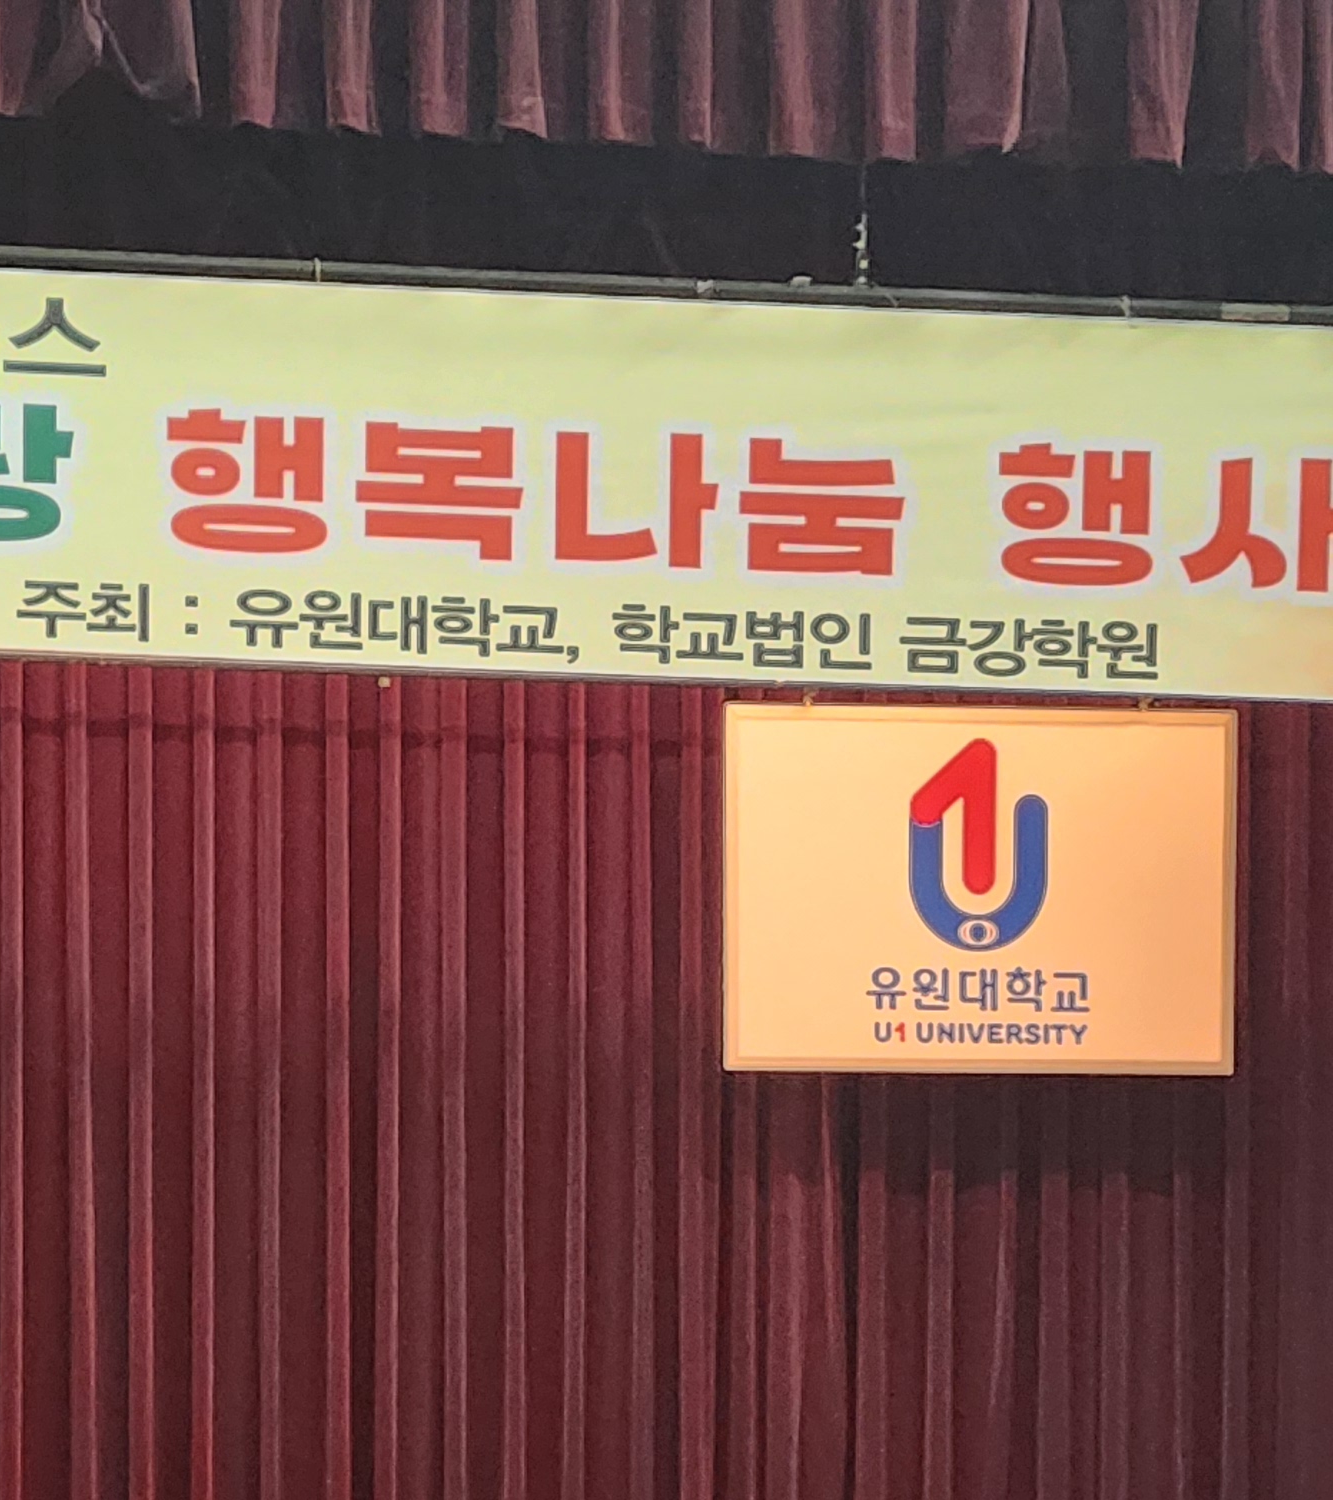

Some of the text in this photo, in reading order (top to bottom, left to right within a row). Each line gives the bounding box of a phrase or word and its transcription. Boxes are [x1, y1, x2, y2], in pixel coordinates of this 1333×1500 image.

[166, 407, 906, 577] 행복나눔
[998, 442, 1333, 594] 행사
[15, 579, 151, 643] 주최
[228, 588, 582, 664] 유원대학교,
[610, 601, 874, 672] 학교법인
[898, 615, 1161, 682] 금강학원
[865, 965, 1091, 1014] 유원대학교
[873, 1021, 1089, 1046] U1 UNIVERSITY
